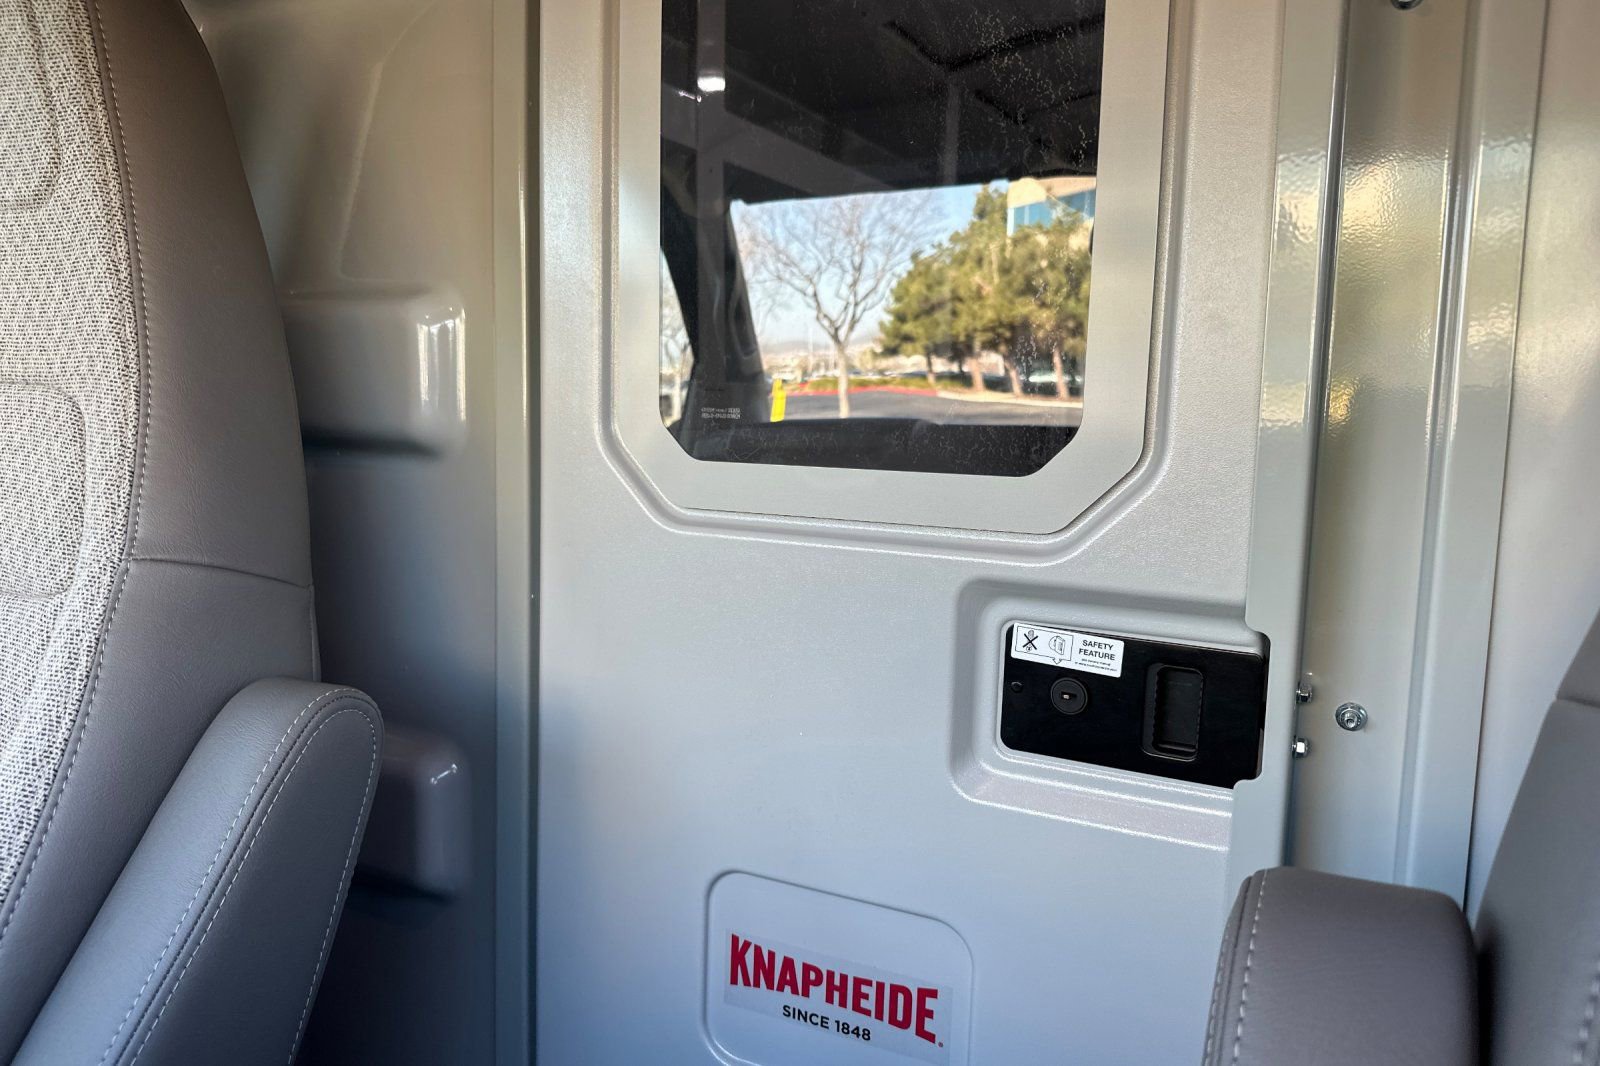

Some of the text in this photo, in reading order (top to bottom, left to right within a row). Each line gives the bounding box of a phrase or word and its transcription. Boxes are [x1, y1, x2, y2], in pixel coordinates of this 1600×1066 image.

[1078, 648, 1115, 661] FEATURE
[1082, 639, 1114, 651] SAFETY
[730, 933, 939, 1044] KNAPHEIDE
[782, 1004, 871, 1041] SINCE 1848
